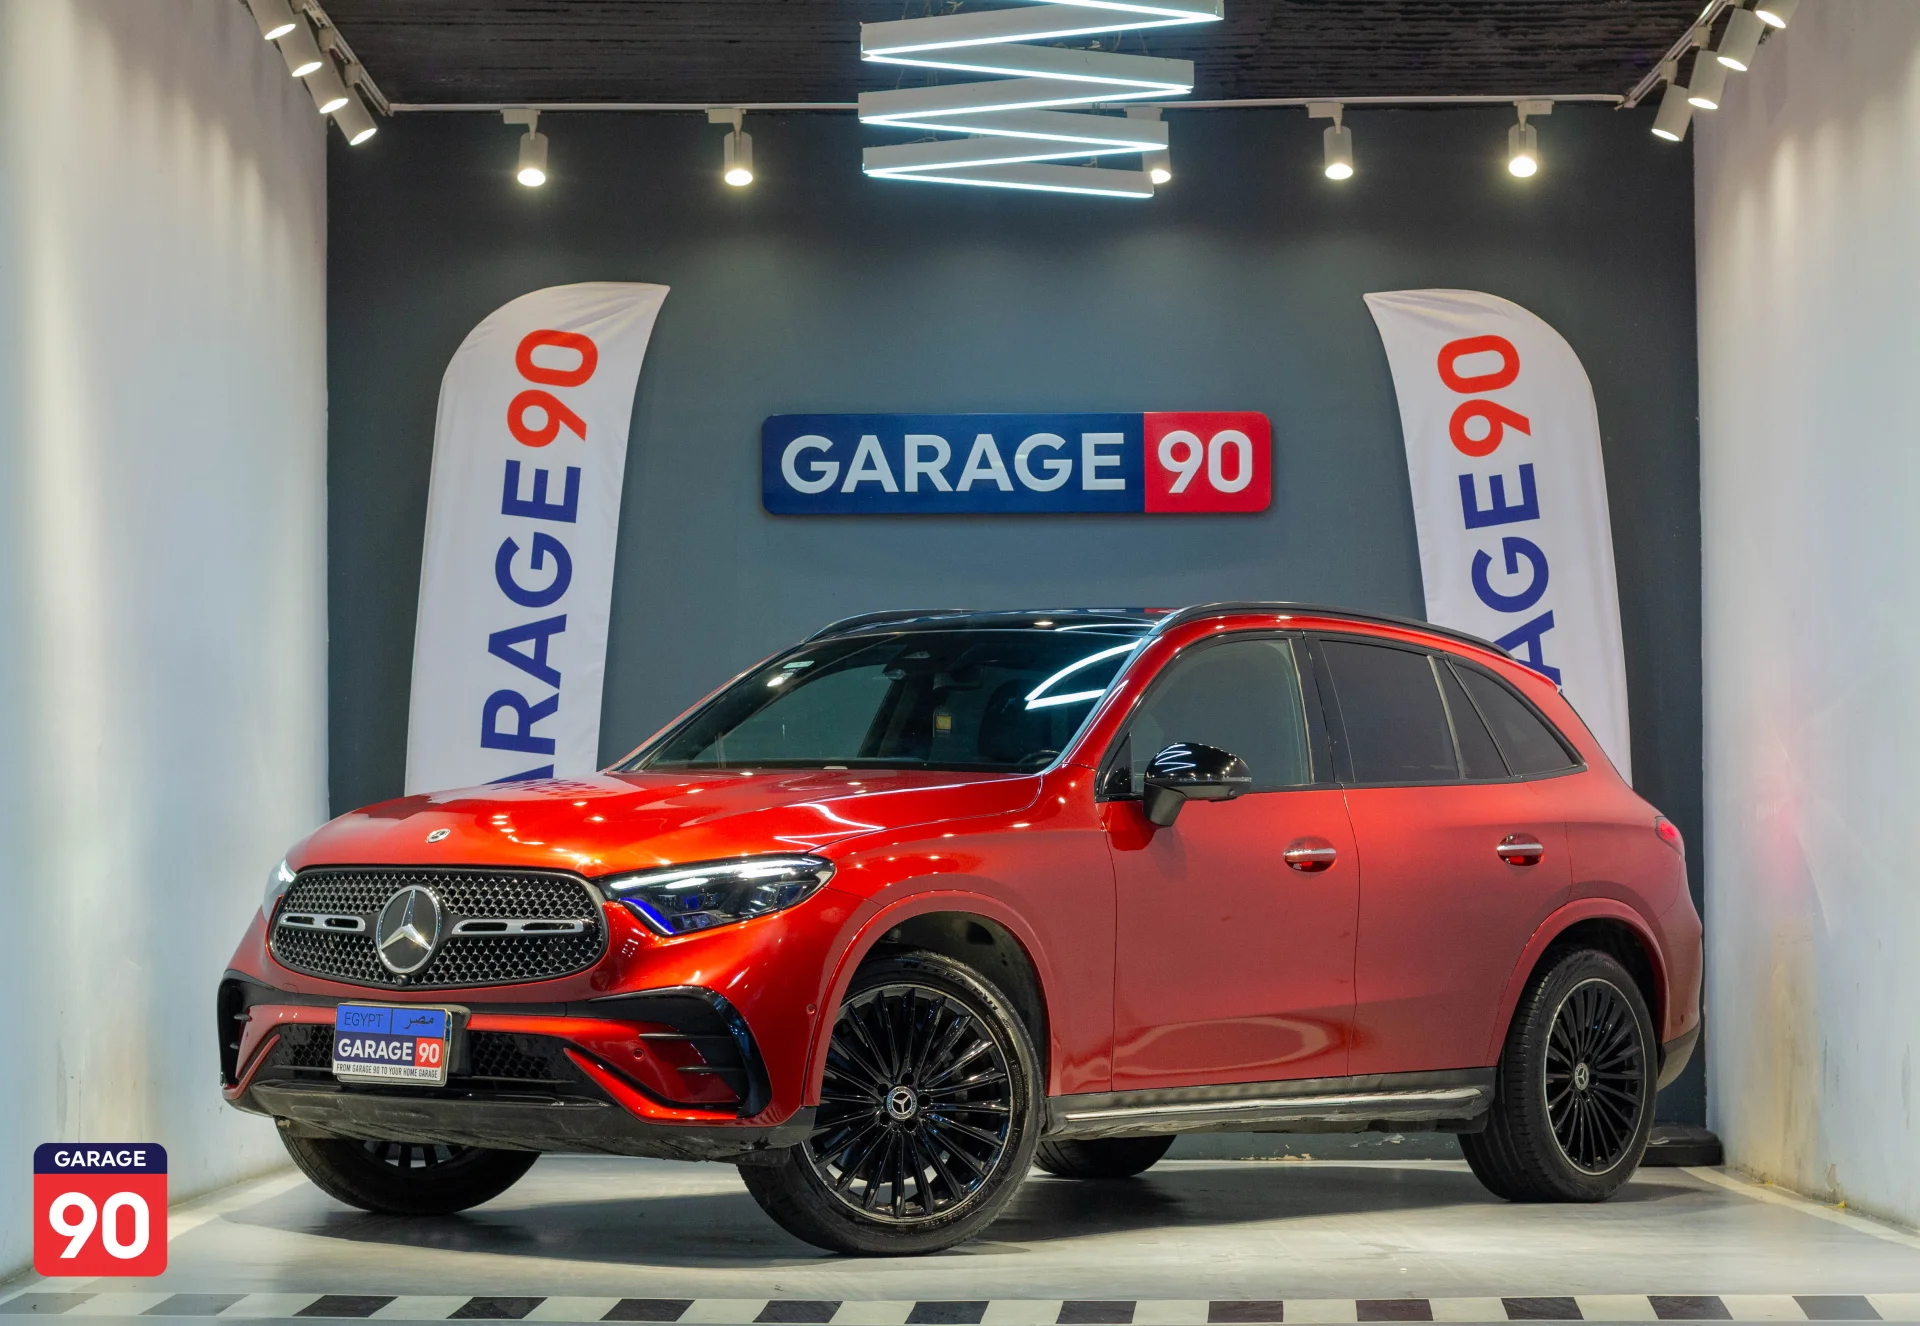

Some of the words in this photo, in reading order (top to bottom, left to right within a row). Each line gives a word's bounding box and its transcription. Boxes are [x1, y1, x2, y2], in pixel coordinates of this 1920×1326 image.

[507, 329, 599, 448] 90
[1437, 334, 1532, 458] 90
[781, 432, 1126, 494] GARAGE
[1157, 430, 1253, 494] 90
[1458, 462, 1563, 693] AGE
[344, 1011, 384, 1028] EGYPT
[403, 1015, 435, 1030] مصر
[336, 1064, 351, 1073] FROM
[352, 1064, 372, 1074] GARAGE
[373, 1066, 380, 1075] 90
[380, 1067, 388, 1075] TO
[389, 1067, 402, 1076] YOUR
[403, 1068, 418, 1077] HOME
[418, 1069, 438, 1079] GARAGE
[338, 1038, 414, 1061] GARAGE
[418, 1042, 440, 1064] 90
